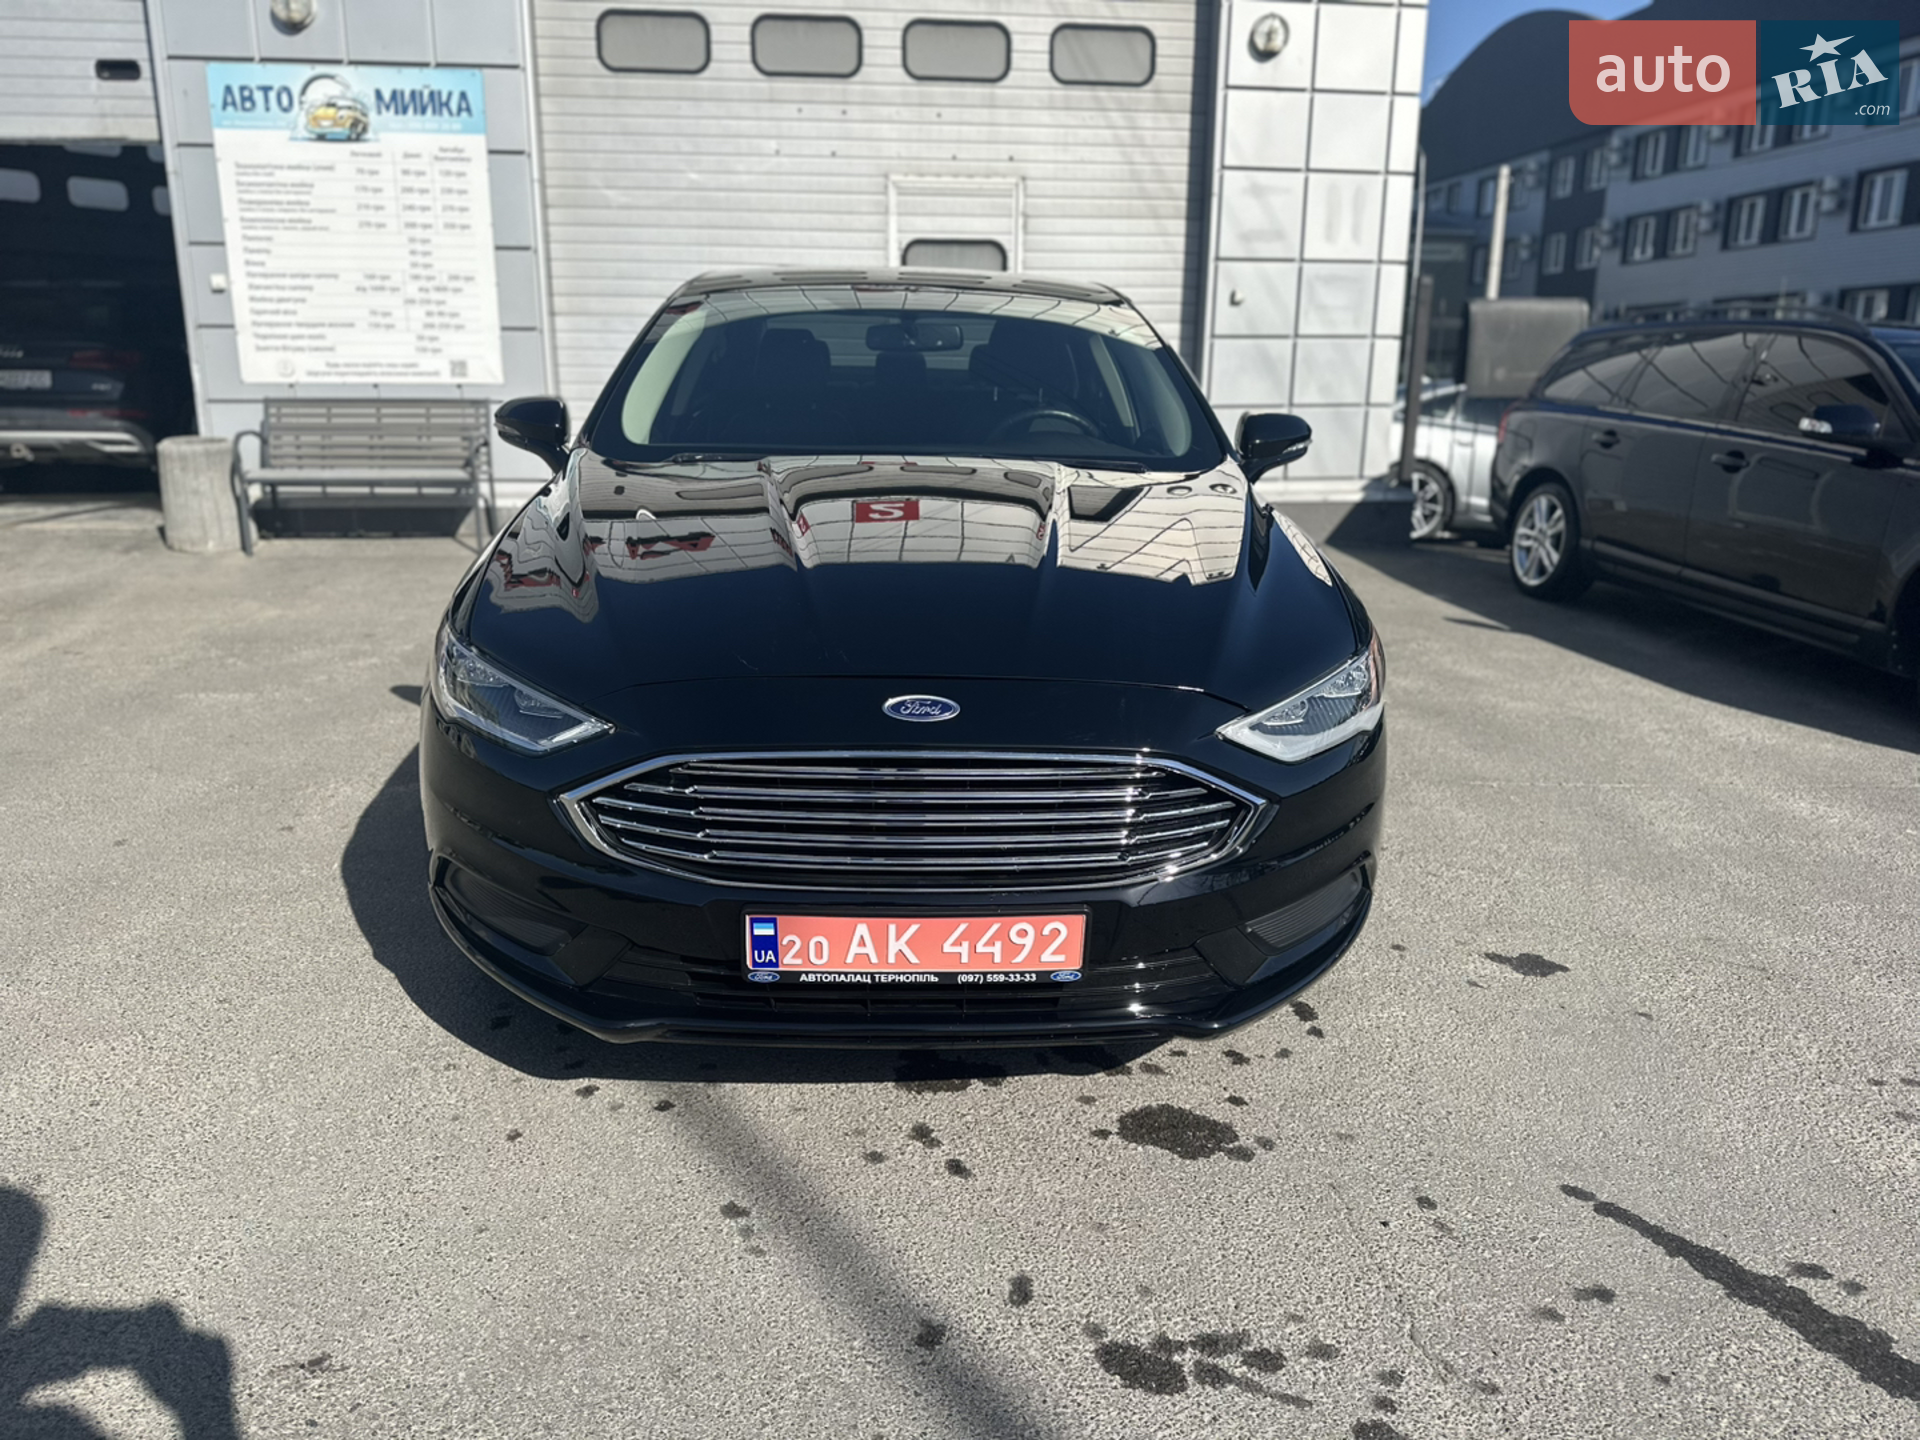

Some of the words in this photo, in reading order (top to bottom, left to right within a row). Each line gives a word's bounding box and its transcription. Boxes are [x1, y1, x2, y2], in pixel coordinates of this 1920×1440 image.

[221, 84, 294, 113] АВТО
[374, 84, 474, 117] МИЙКА
[900, 699, 943, 716] Ford
[780, 934, 830, 966] 20
[844, 923, 922, 965] AK
[941, 920, 1070, 964] 4492
[754, 950, 777, 964] UA
[799, 973, 872, 984] АВТОПАЛАЦ
[873, 973, 940, 983] ТЕРНОПІЛЬ
[957, 973, 984, 985] (097)
[986, 972, 1037, 982] 559-33-33
